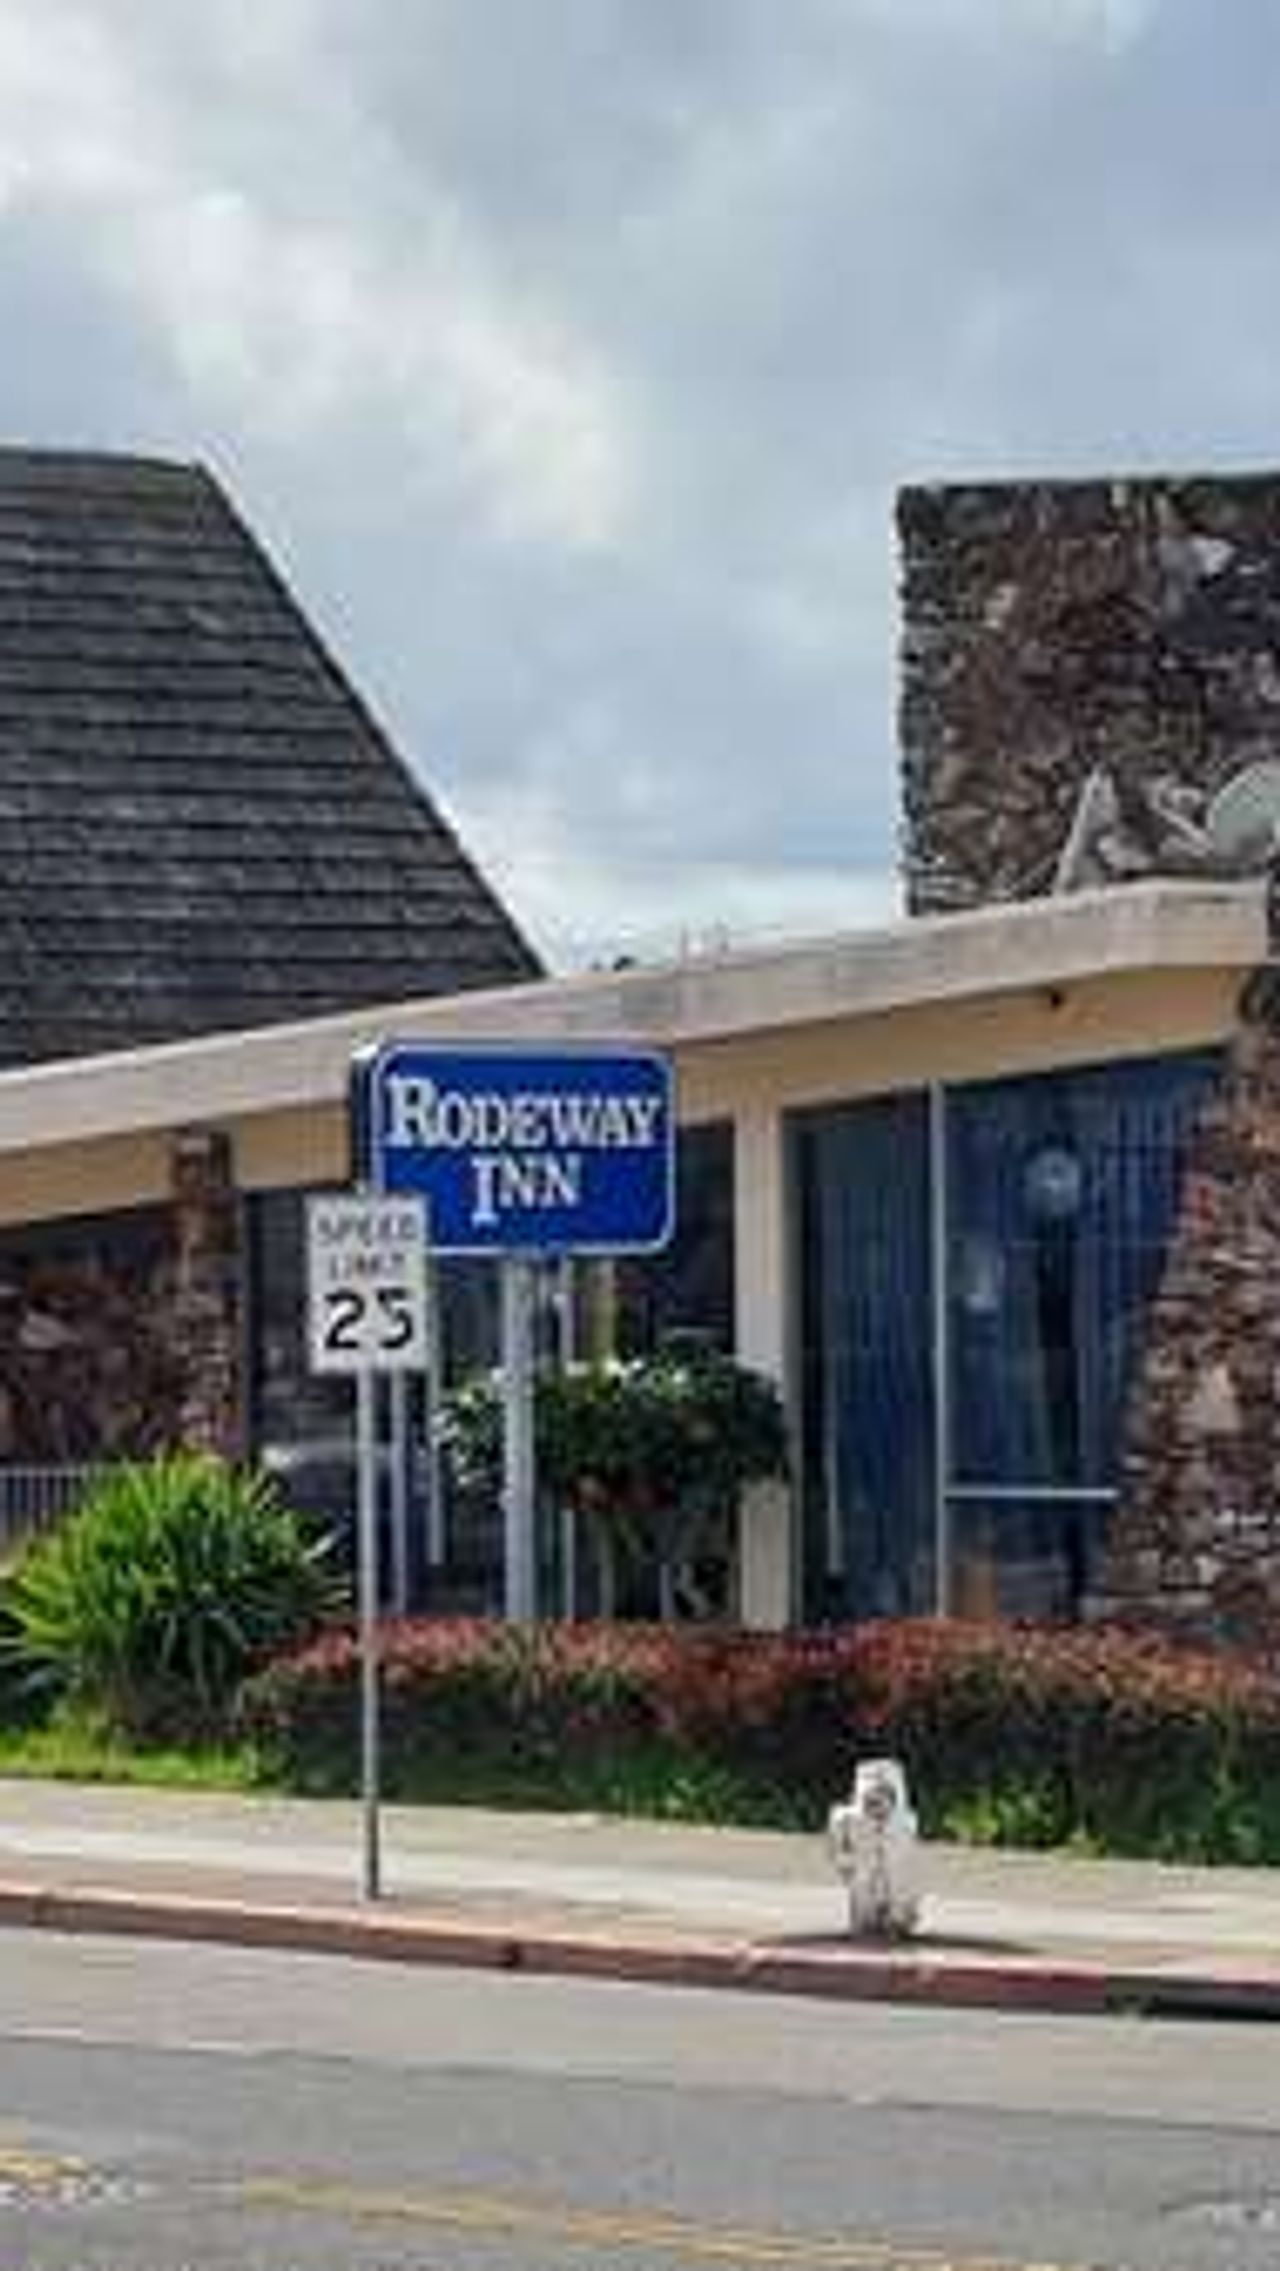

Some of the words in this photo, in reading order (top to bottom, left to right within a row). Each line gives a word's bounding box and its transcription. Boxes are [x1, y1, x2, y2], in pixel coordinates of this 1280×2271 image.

[386, 1075, 661, 1148] RODEWAY
[471, 1154, 582, 1227] INN
[324, 1287, 413, 1350] 25
